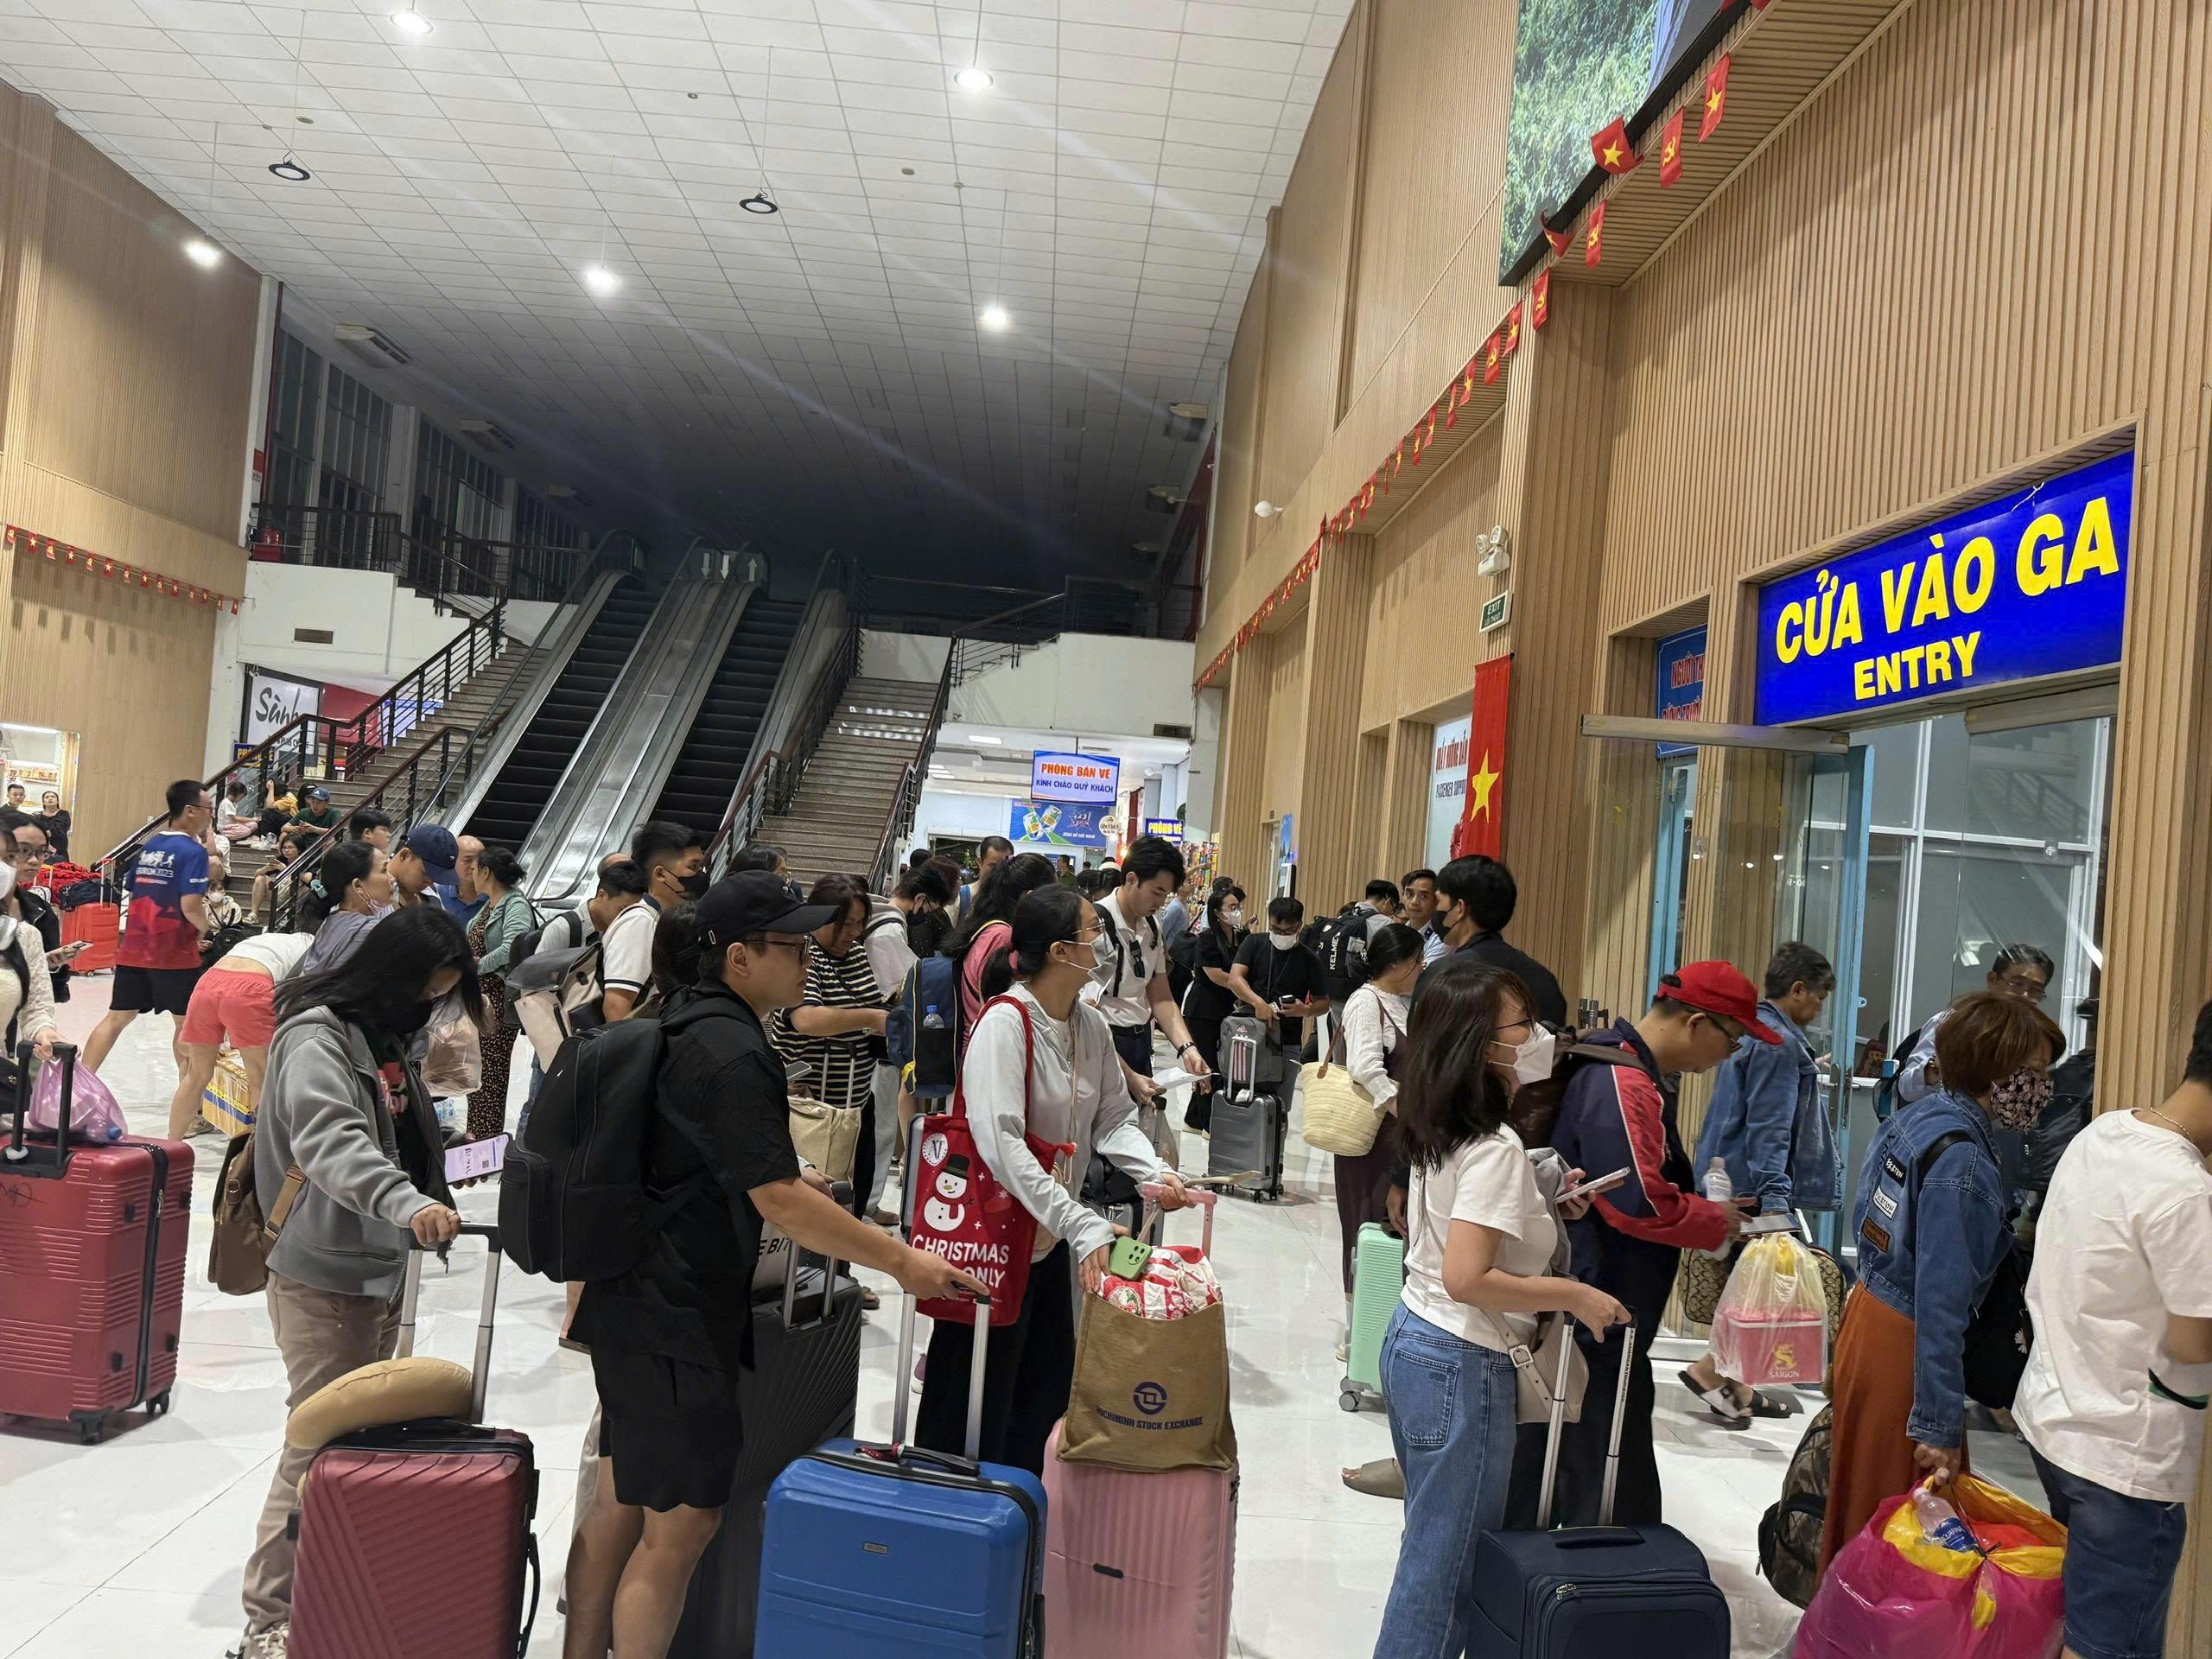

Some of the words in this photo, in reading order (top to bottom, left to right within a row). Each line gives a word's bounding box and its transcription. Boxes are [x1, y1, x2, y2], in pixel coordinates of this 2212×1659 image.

[1776, 569, 1863, 664] CỬA
[1880, 533, 1996, 634] VÀO
[2016, 496, 2120, 597] GA
[1487, 600, 1502, 615] EXIT
[1694, 653, 1705, 683] TH
[1854, 631, 1981, 701] ENTRY
[1041, 762, 1073, 776] PHÒNG
[1077, 766, 1096, 778] BÁN
[1098, 767, 1111, 779] VÉ
[1036, 779, 1052, 787] KÍNH
[1053, 780, 1072, 789] CHÀO
[1090, 784, 1114, 793] KHÁCH
[1147, 821, 1173, 835] PHÒNG
[1329, 936, 1340, 970] KELME
[912, 1234, 1010, 1265] CHRISTMAS
[1769, 1369, 1800, 1379] SAIGON
[1136, 1420, 1163, 1431] STOCK
[1165, 1416, 1204, 1430] EXCHANGE
